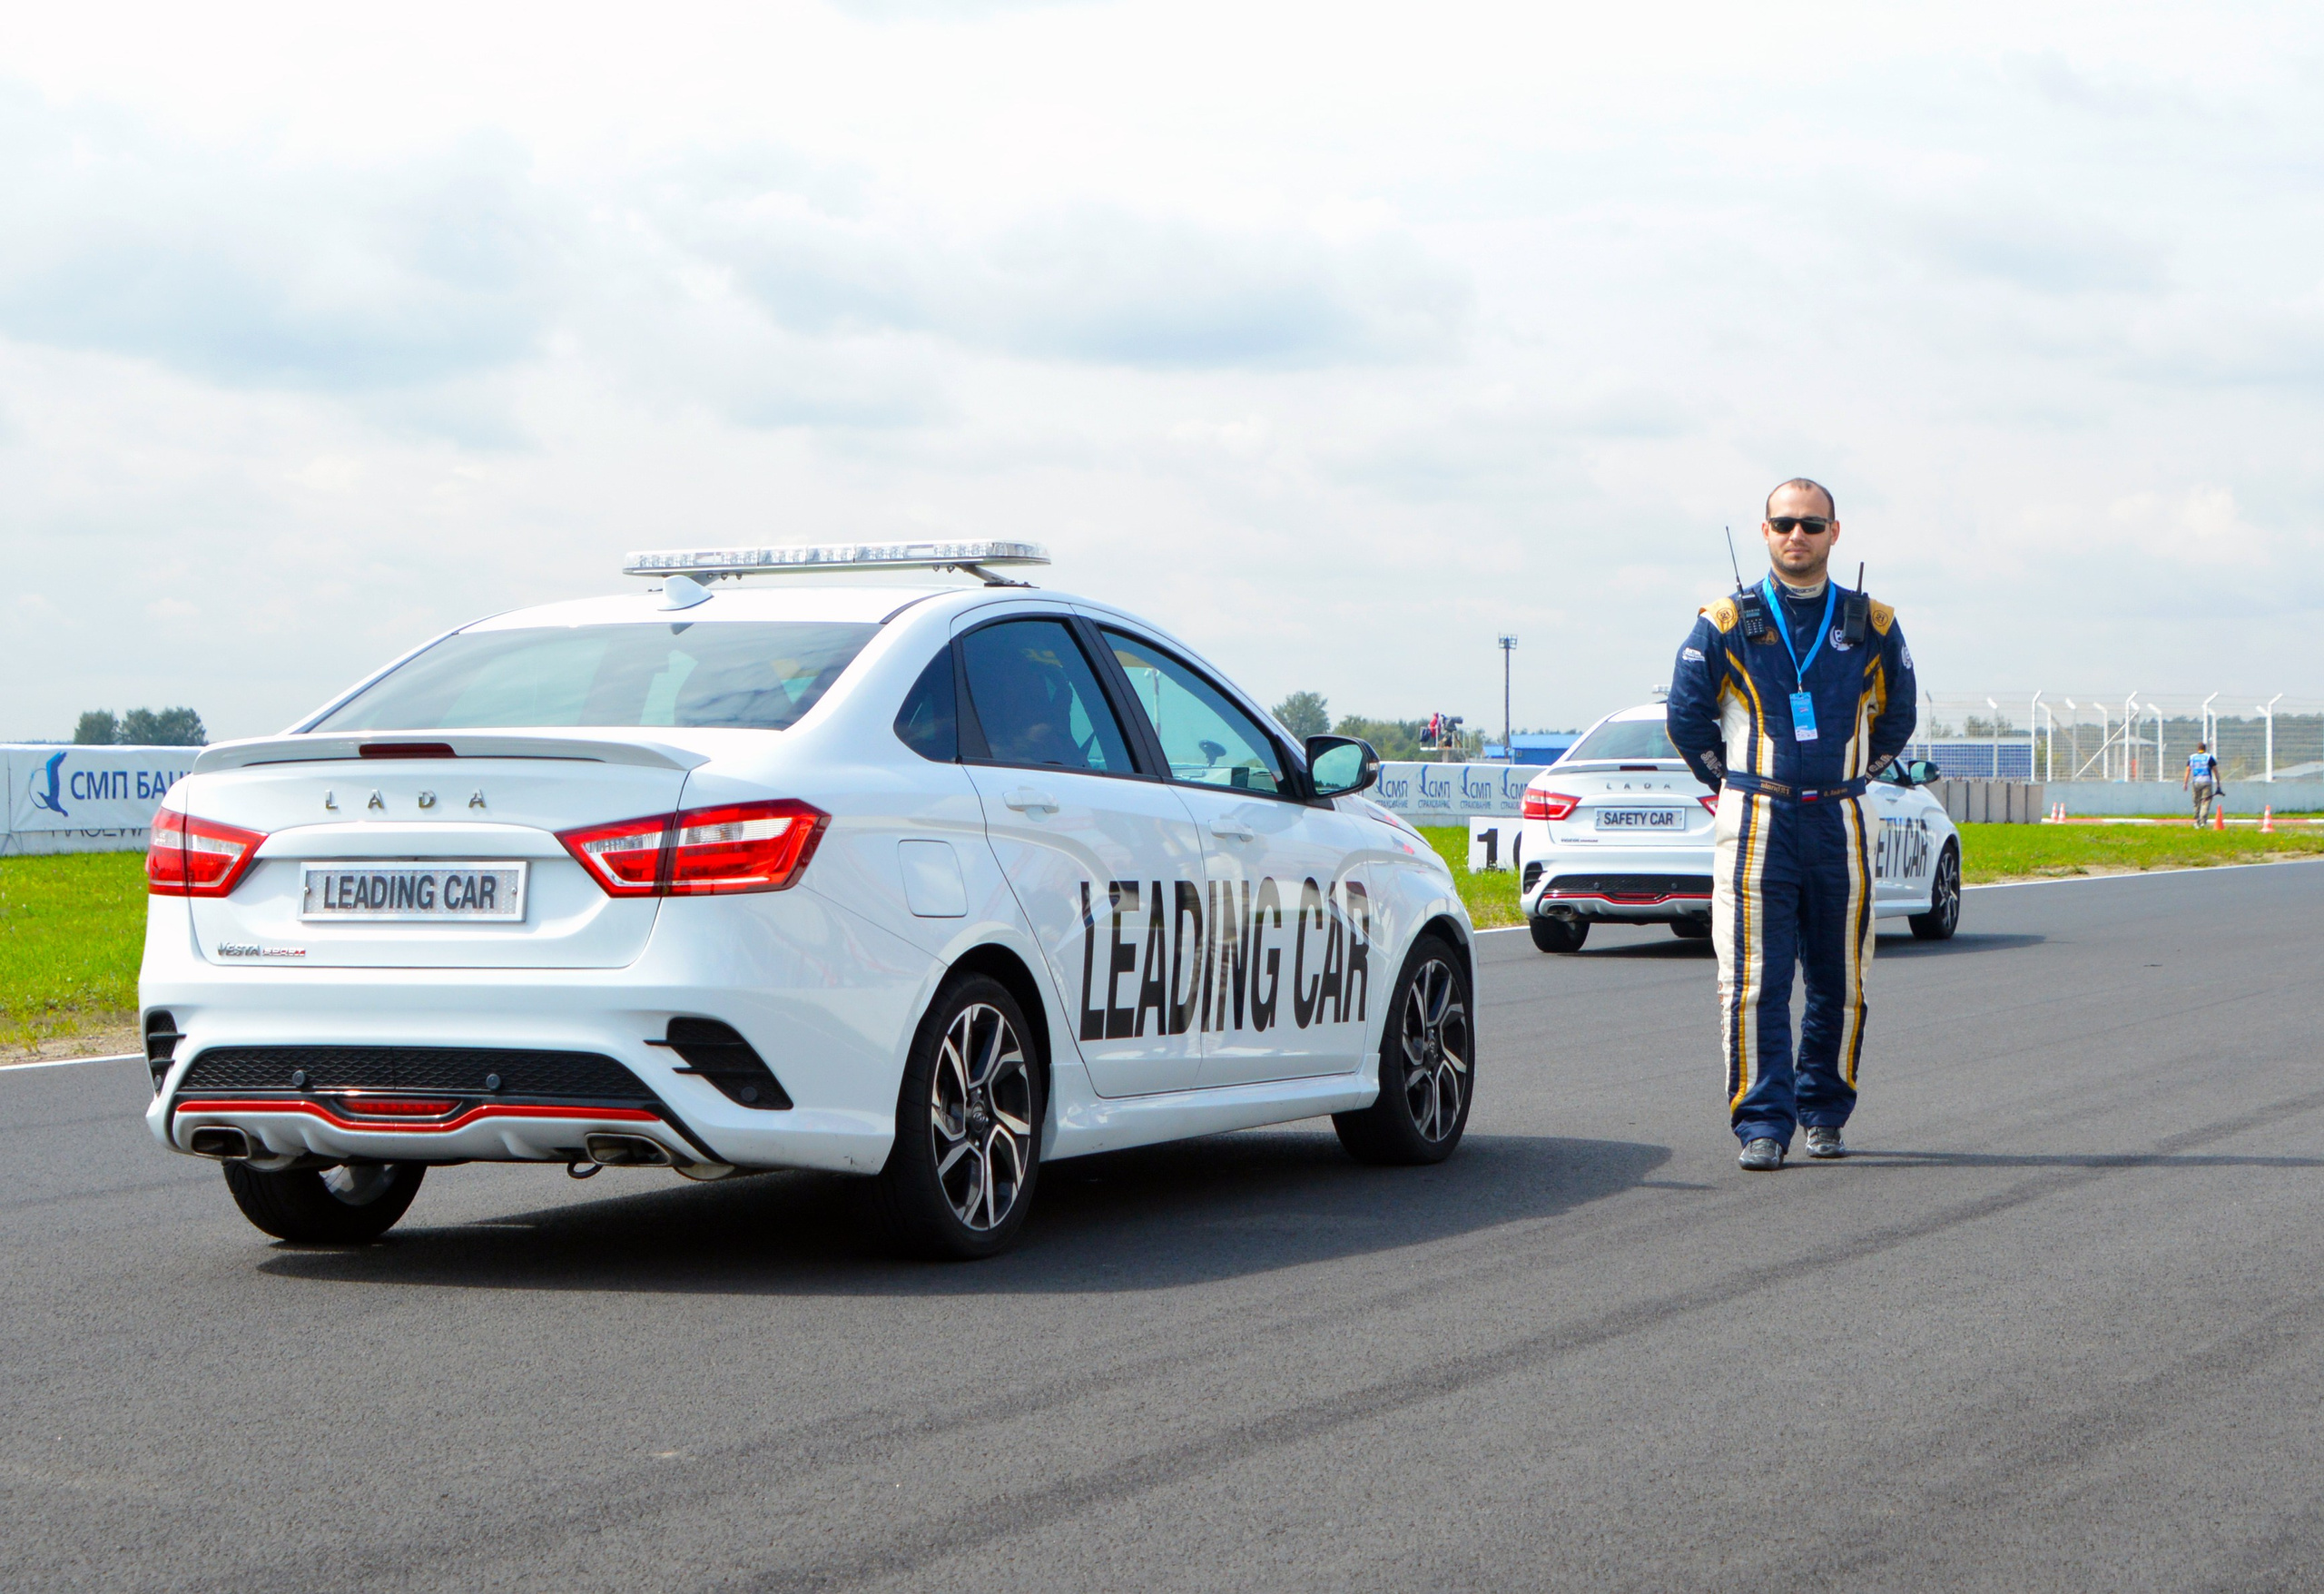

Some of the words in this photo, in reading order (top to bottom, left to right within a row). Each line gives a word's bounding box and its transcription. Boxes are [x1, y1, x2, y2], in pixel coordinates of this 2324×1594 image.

[70, 771, 128, 801] СМП
[136, 771, 192, 800] БА
[1385, 781, 1409, 798] СМП
[1428, 781, 1451, 798] СМП
[1470, 782, 1492, 800] СМП
[325, 789, 487, 809] LADA
[1603, 812, 1648, 825] SAFETY
[1649, 812, 1674, 825] CAR
[1904, 816, 1930, 879] CAR
[323, 874, 435, 910] LEADING
[444, 874, 497, 910] CAR
[218, 940, 261, 957] VESTA
[1079, 877, 1282, 1041] LEADING
[1294, 877, 1370, 1030] CAR
